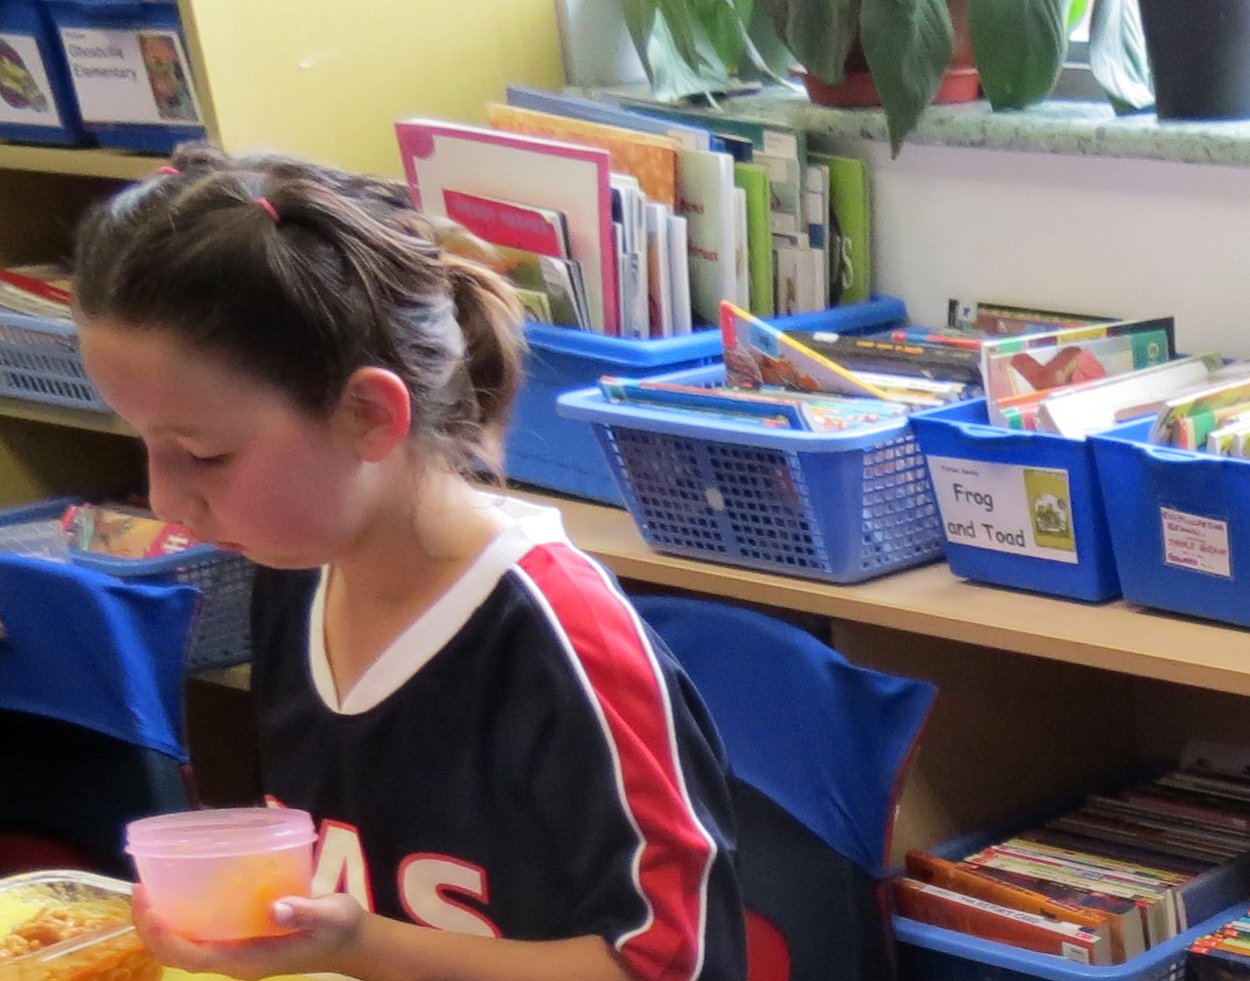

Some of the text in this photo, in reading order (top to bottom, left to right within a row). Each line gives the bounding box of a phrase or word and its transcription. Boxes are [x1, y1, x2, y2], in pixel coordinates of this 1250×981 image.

[73, 64, 137, 84] Elementary
[953, 483, 994, 512] Frog
[947, 521, 1026, 548] and Toad
[264, 794, 503, 939] AS
[974, 899, 1013, 917] REPORT
[1013, 912, 1041, 925] CARD
